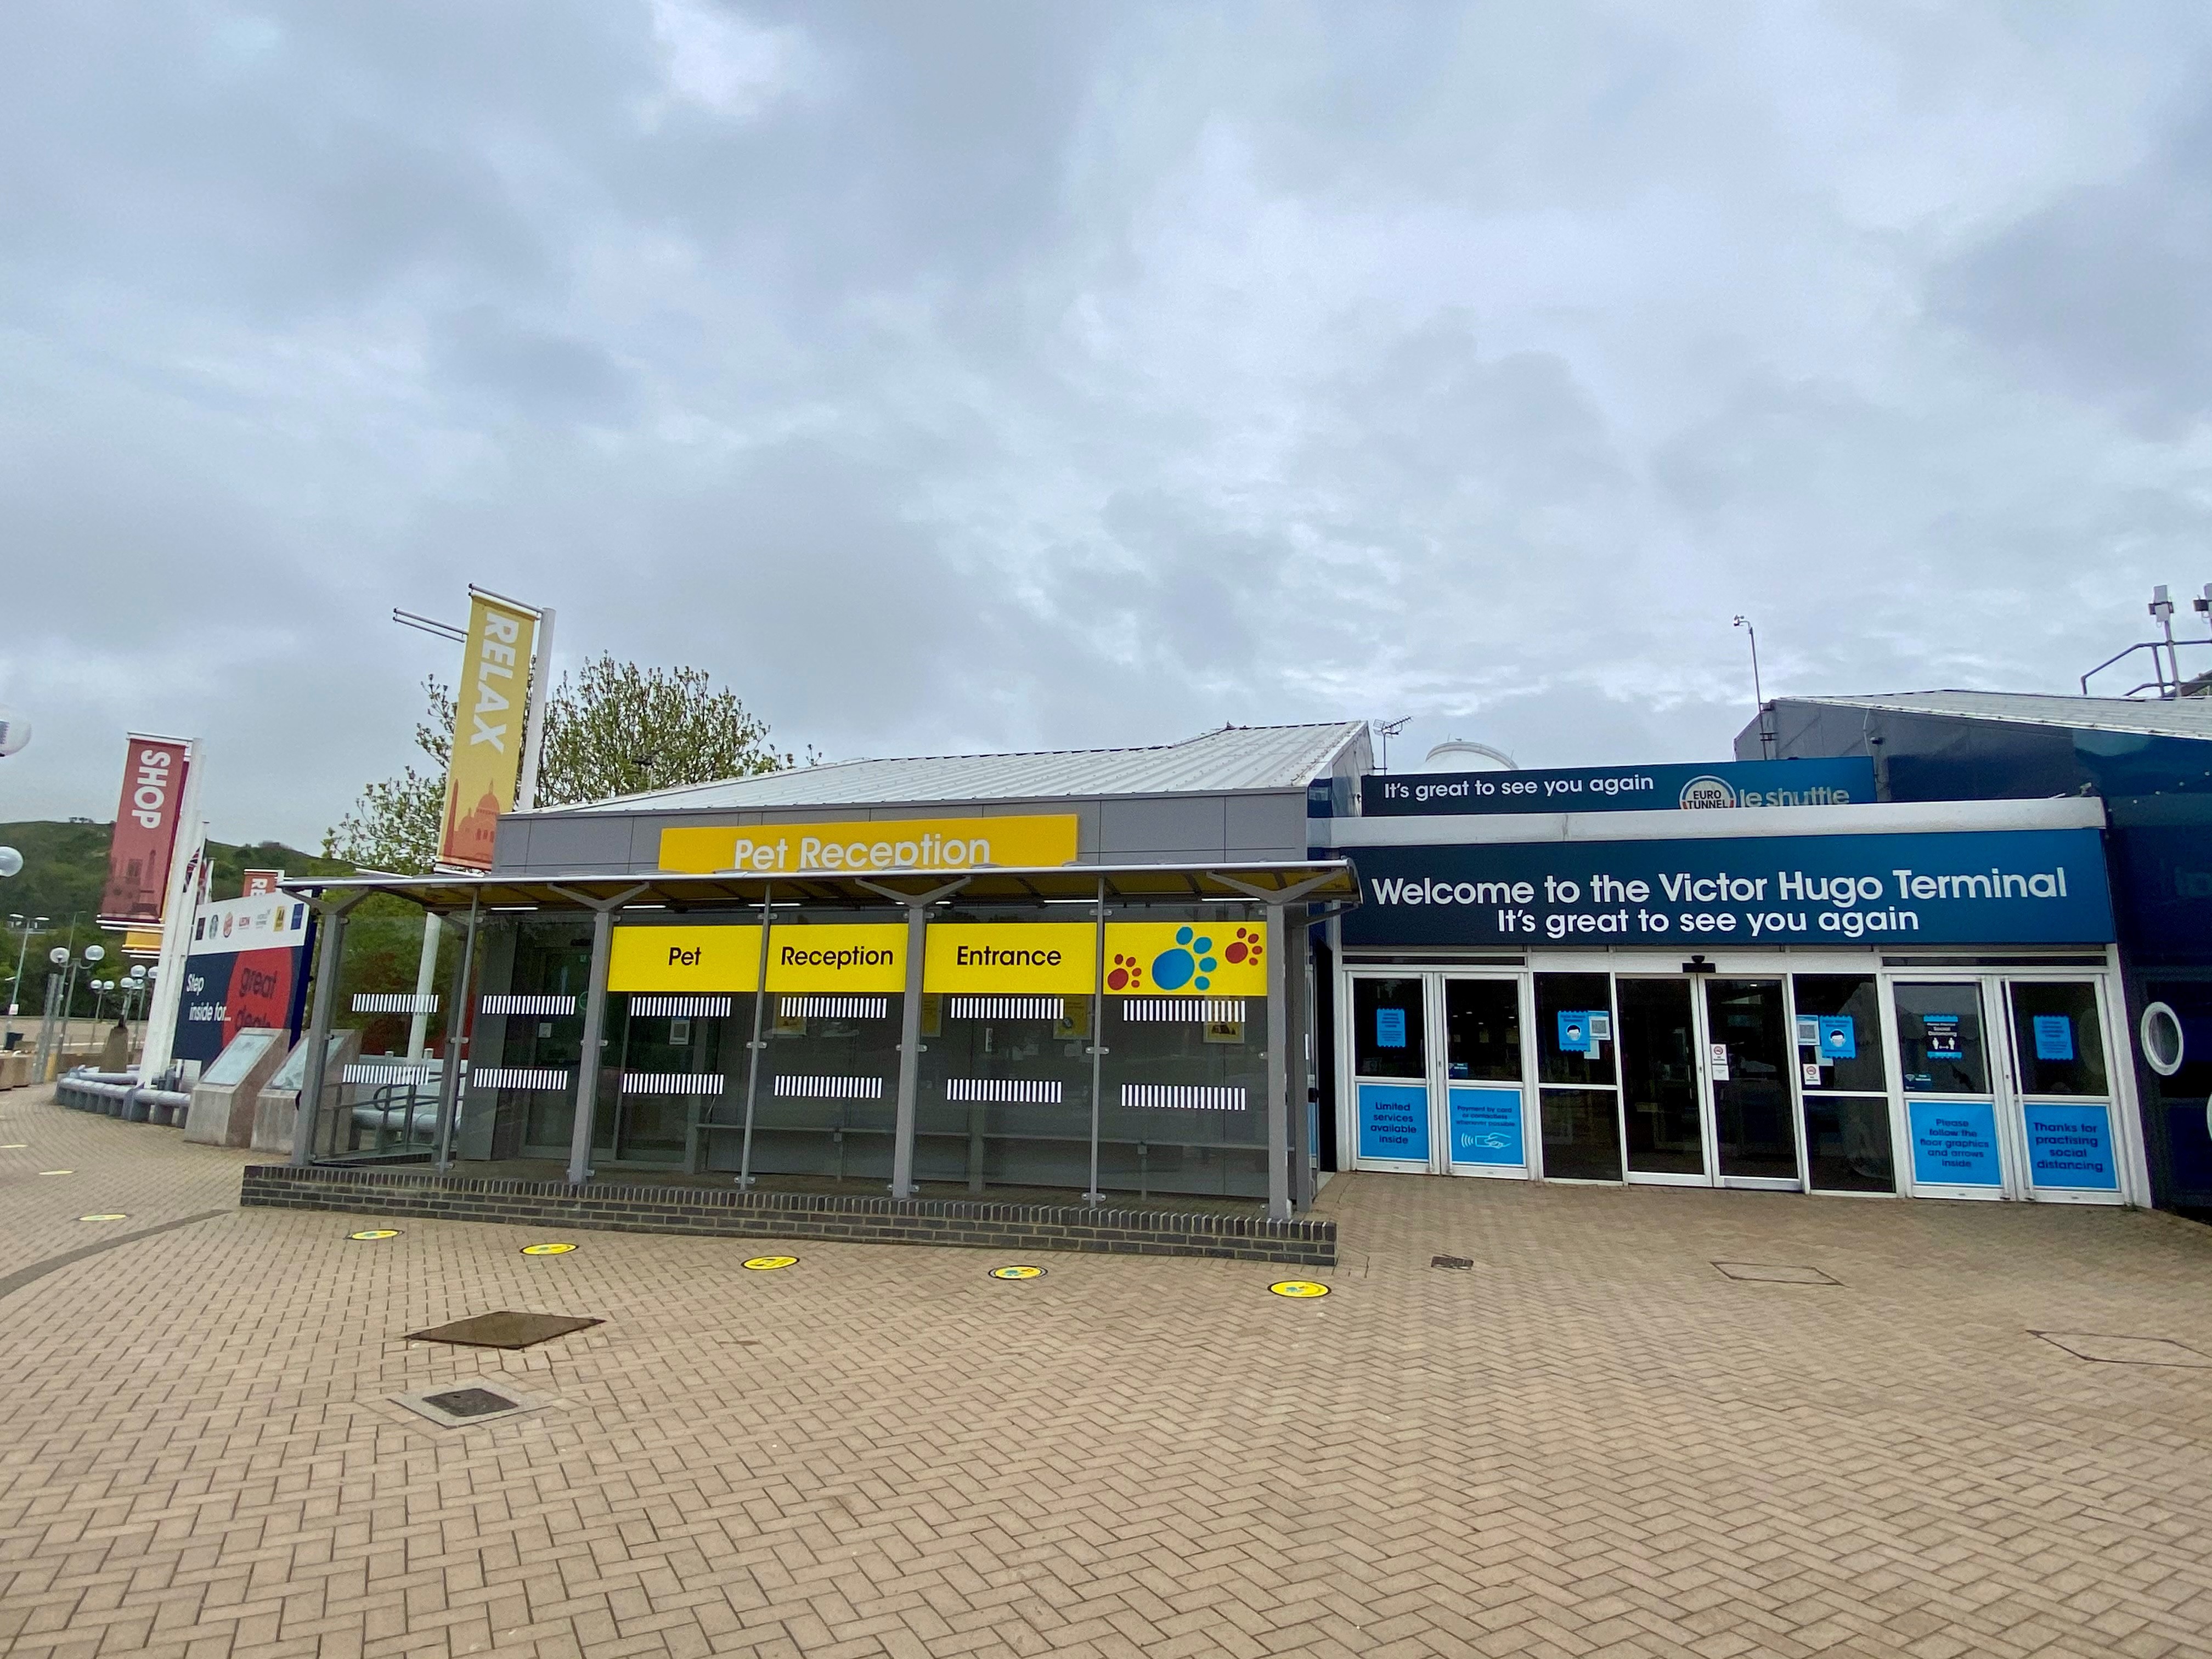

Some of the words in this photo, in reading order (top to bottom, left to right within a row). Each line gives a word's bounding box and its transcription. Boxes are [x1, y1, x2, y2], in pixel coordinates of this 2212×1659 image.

[470, 612, 519, 755] RELAX
[132, 749, 171, 829] SHOP
[1384, 782, 1409, 799] It's
[1415, 780, 1469, 802] great
[1475, 780, 1495, 795] to
[1502, 780, 1538, 794] see
[1544, 777, 1582, 797] you
[1590, 774, 1654, 795] again
[1693, 790, 1722, 800] EURO
[1687, 799, 1729, 809] TUNNEL
[735, 838, 788, 870] Pet
[800, 833, 990, 868] Reception
[1372, 877, 1535, 905] Welcome
[1544, 875, 1581, 904] to
[1589, 874, 1650, 903] the
[1658, 872, 1768, 902] Victor
[1778, 871, 1883, 909] Hugo
[1892, 867, 2068, 900] Terminal
[1498, 909, 1536, 933] It's
[1545, 909, 1629, 939] great
[1638, 909, 1669, 932] to
[1679, 911, 1737, 932] see
[1746, 911, 1808, 937] you
[1818, 906, 1920, 938] again
[669, 947, 701, 966] Pet
[781, 945, 894, 970] Reception
[957, 946, 1062, 966] Entrance
[186, 974, 204, 996] Step
[239, 967, 278, 999] great
[189, 1001, 213, 1022] inside
[1375, 1102, 1410, 1111] Limited
[1374, 1113, 1413, 1122] services
[1936, 1118, 1969, 1127] Please
[1370, 1124, 1417, 1133] available
[2033, 1122, 2078, 1132] Thanks
[2081, 1123, 2097, 1133] for
[1379, 1134, 1408, 1144] inside
[1920, 1138, 1942, 1147] floor
[1945, 1139, 1989, 1148] graphics
[2036, 1136, 2098, 1148] practising
[2050, 1148, 2087, 1158] social
[1942, 1159, 1972, 1167] inside
[2036, 1159, 2103, 1172] distancing
